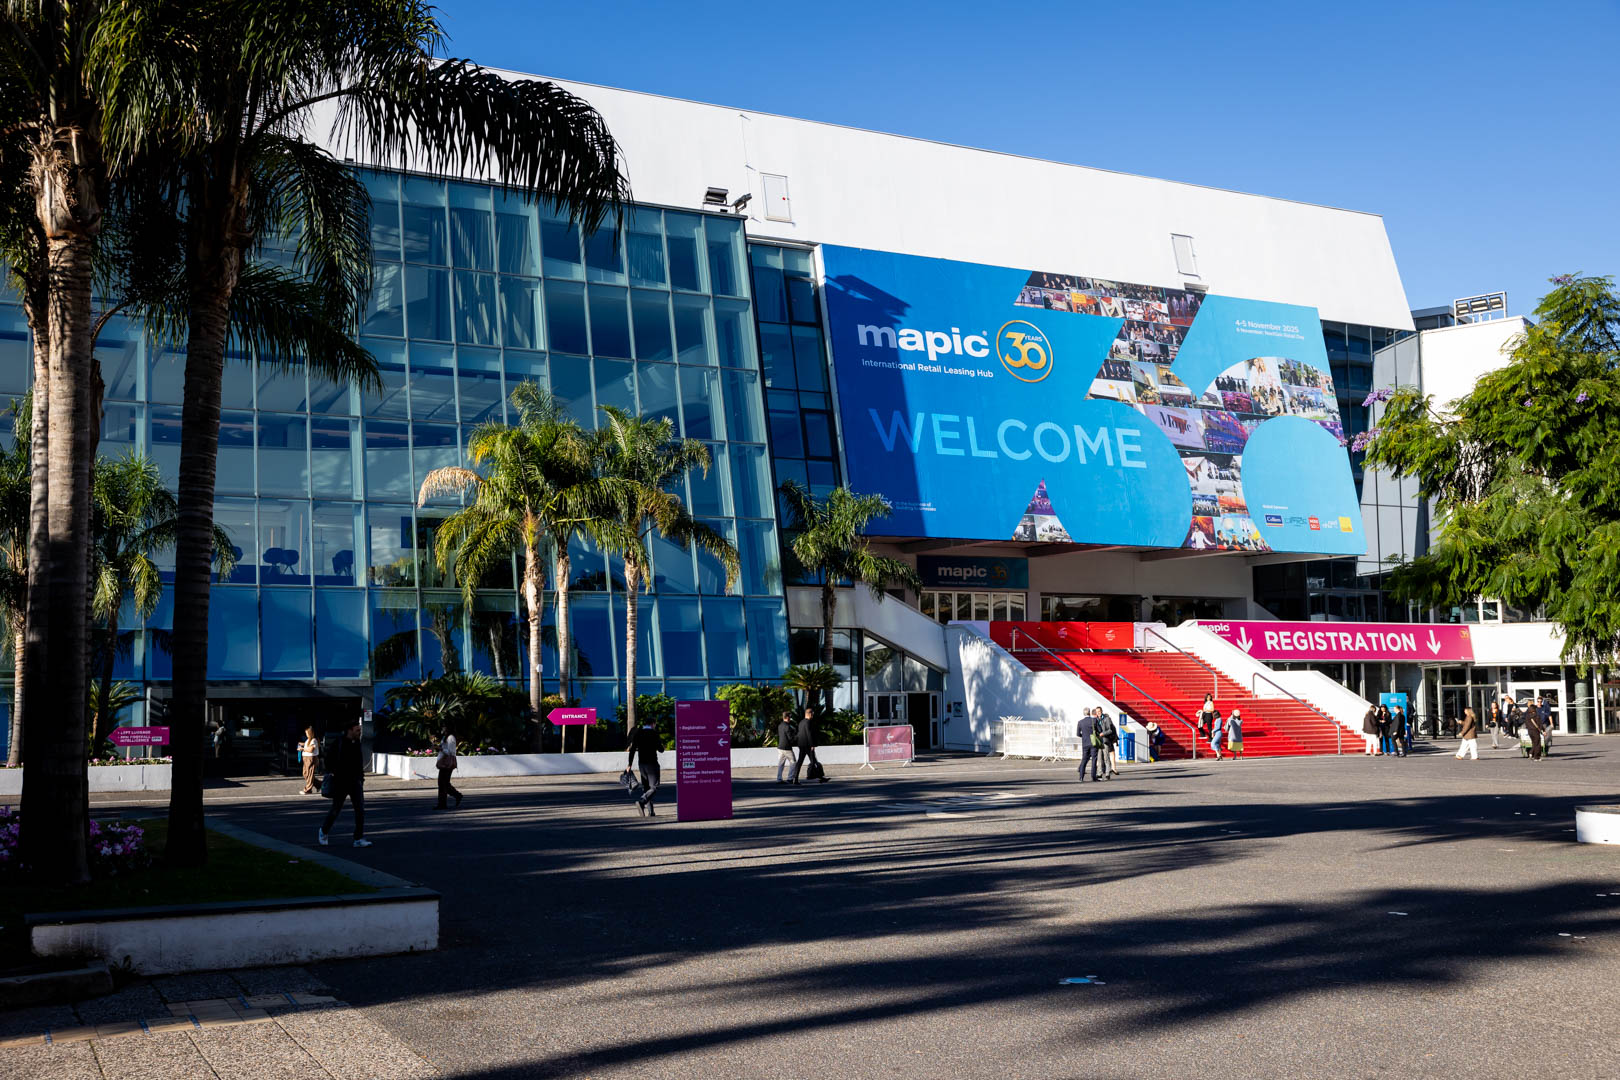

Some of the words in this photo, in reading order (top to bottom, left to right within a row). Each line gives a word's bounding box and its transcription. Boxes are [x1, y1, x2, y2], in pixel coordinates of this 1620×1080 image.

[1248, 320, 1281, 331] November
[1005, 331, 1047, 370] 30
[861, 359, 916, 371] International
[917, 363, 942, 373] Retail
[943, 366, 975, 378] Leasing
[977, 369, 994, 378] Hub
[868, 408, 1147, 468] WELCOME
[937, 565, 987, 581] mapic
[1264, 631, 1417, 652] REGISTRATION
